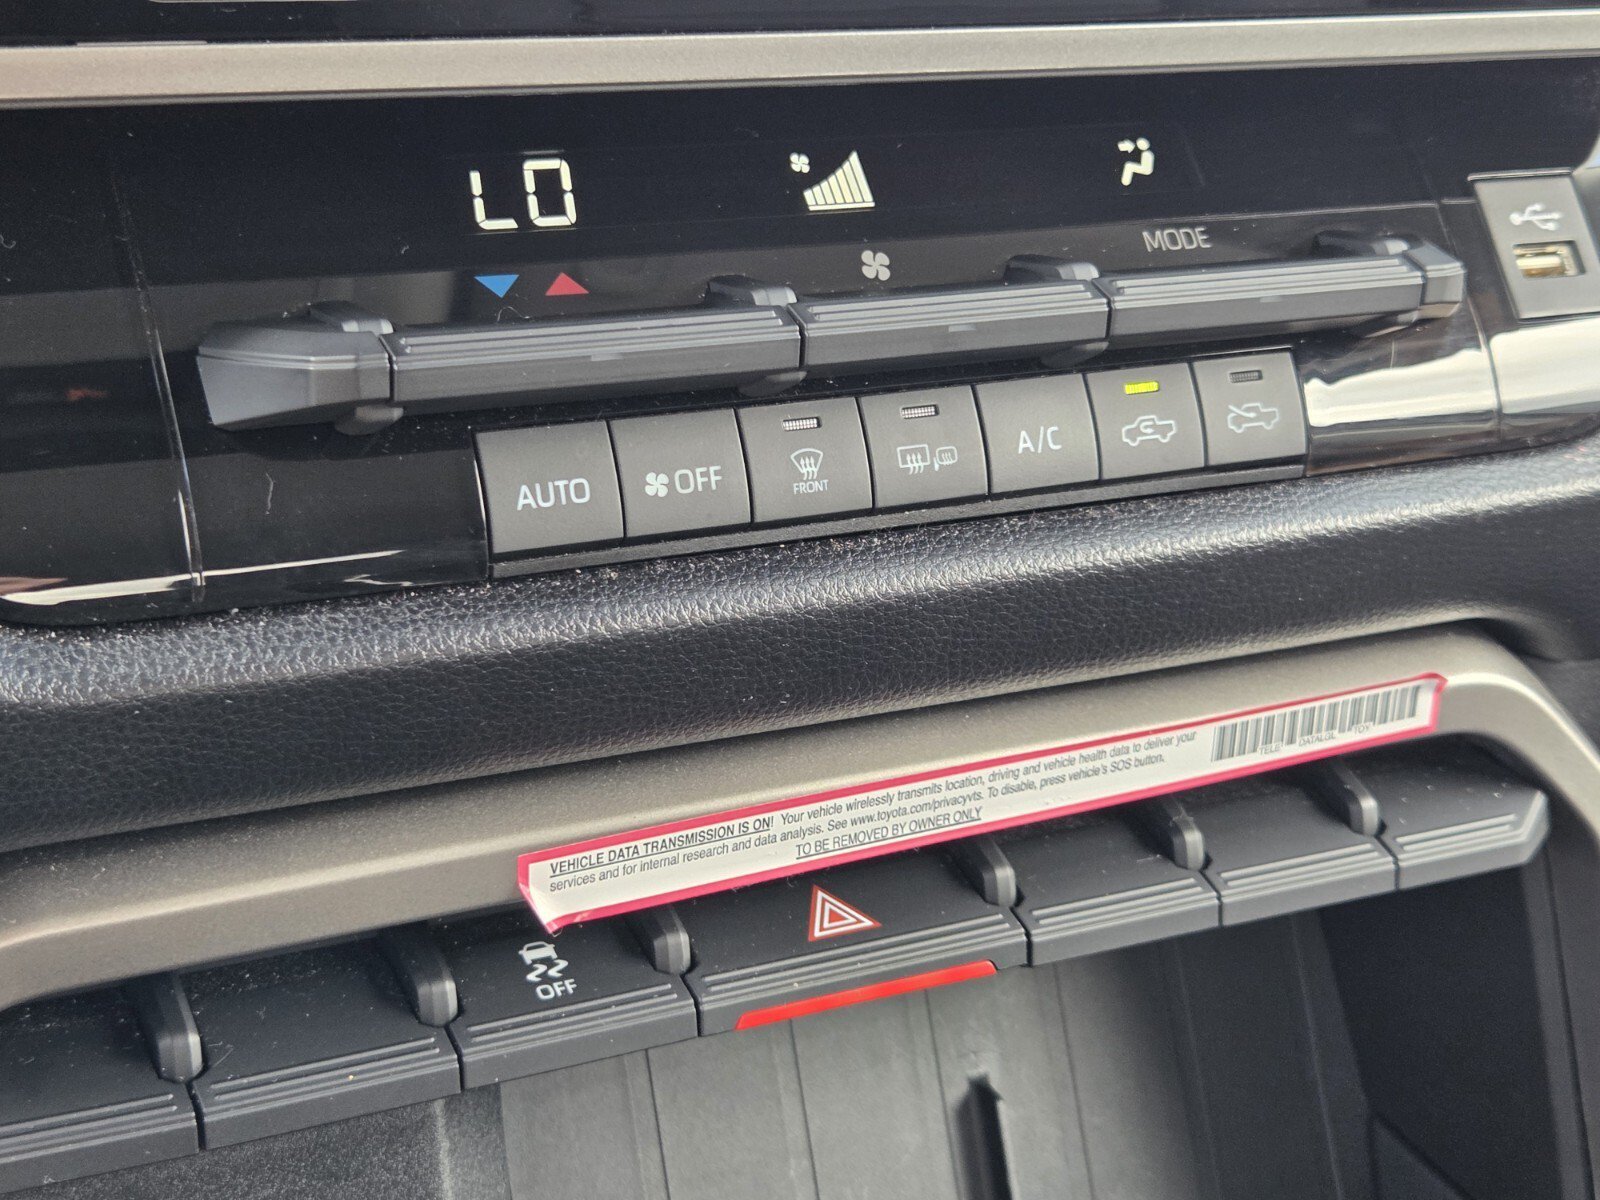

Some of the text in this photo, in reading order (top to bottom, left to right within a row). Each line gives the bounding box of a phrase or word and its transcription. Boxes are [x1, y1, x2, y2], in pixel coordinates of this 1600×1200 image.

[1142, 227, 1212, 252] MODE
[1018, 426, 1062, 454] A/C
[516, 477, 591, 511] AUTO
[674, 465, 722, 494] OFF
[793, 479, 829, 495] FRONT
[550, 731, 1197, 875] VEHICLE DATA TRANSMISSION IS ON! Your vehicle wirelessly transmits location, driving and vehicle health data to deliver your
[549, 753, 1165, 892] services and for internal research and data analysis. See www.toyota.com/privacyvts. To disable, press vehicle's SOS button.
[795, 805, 983, 857] TO BE REMOVED BY OWNER ONLY
[536, 978, 578, 1000] OFF
